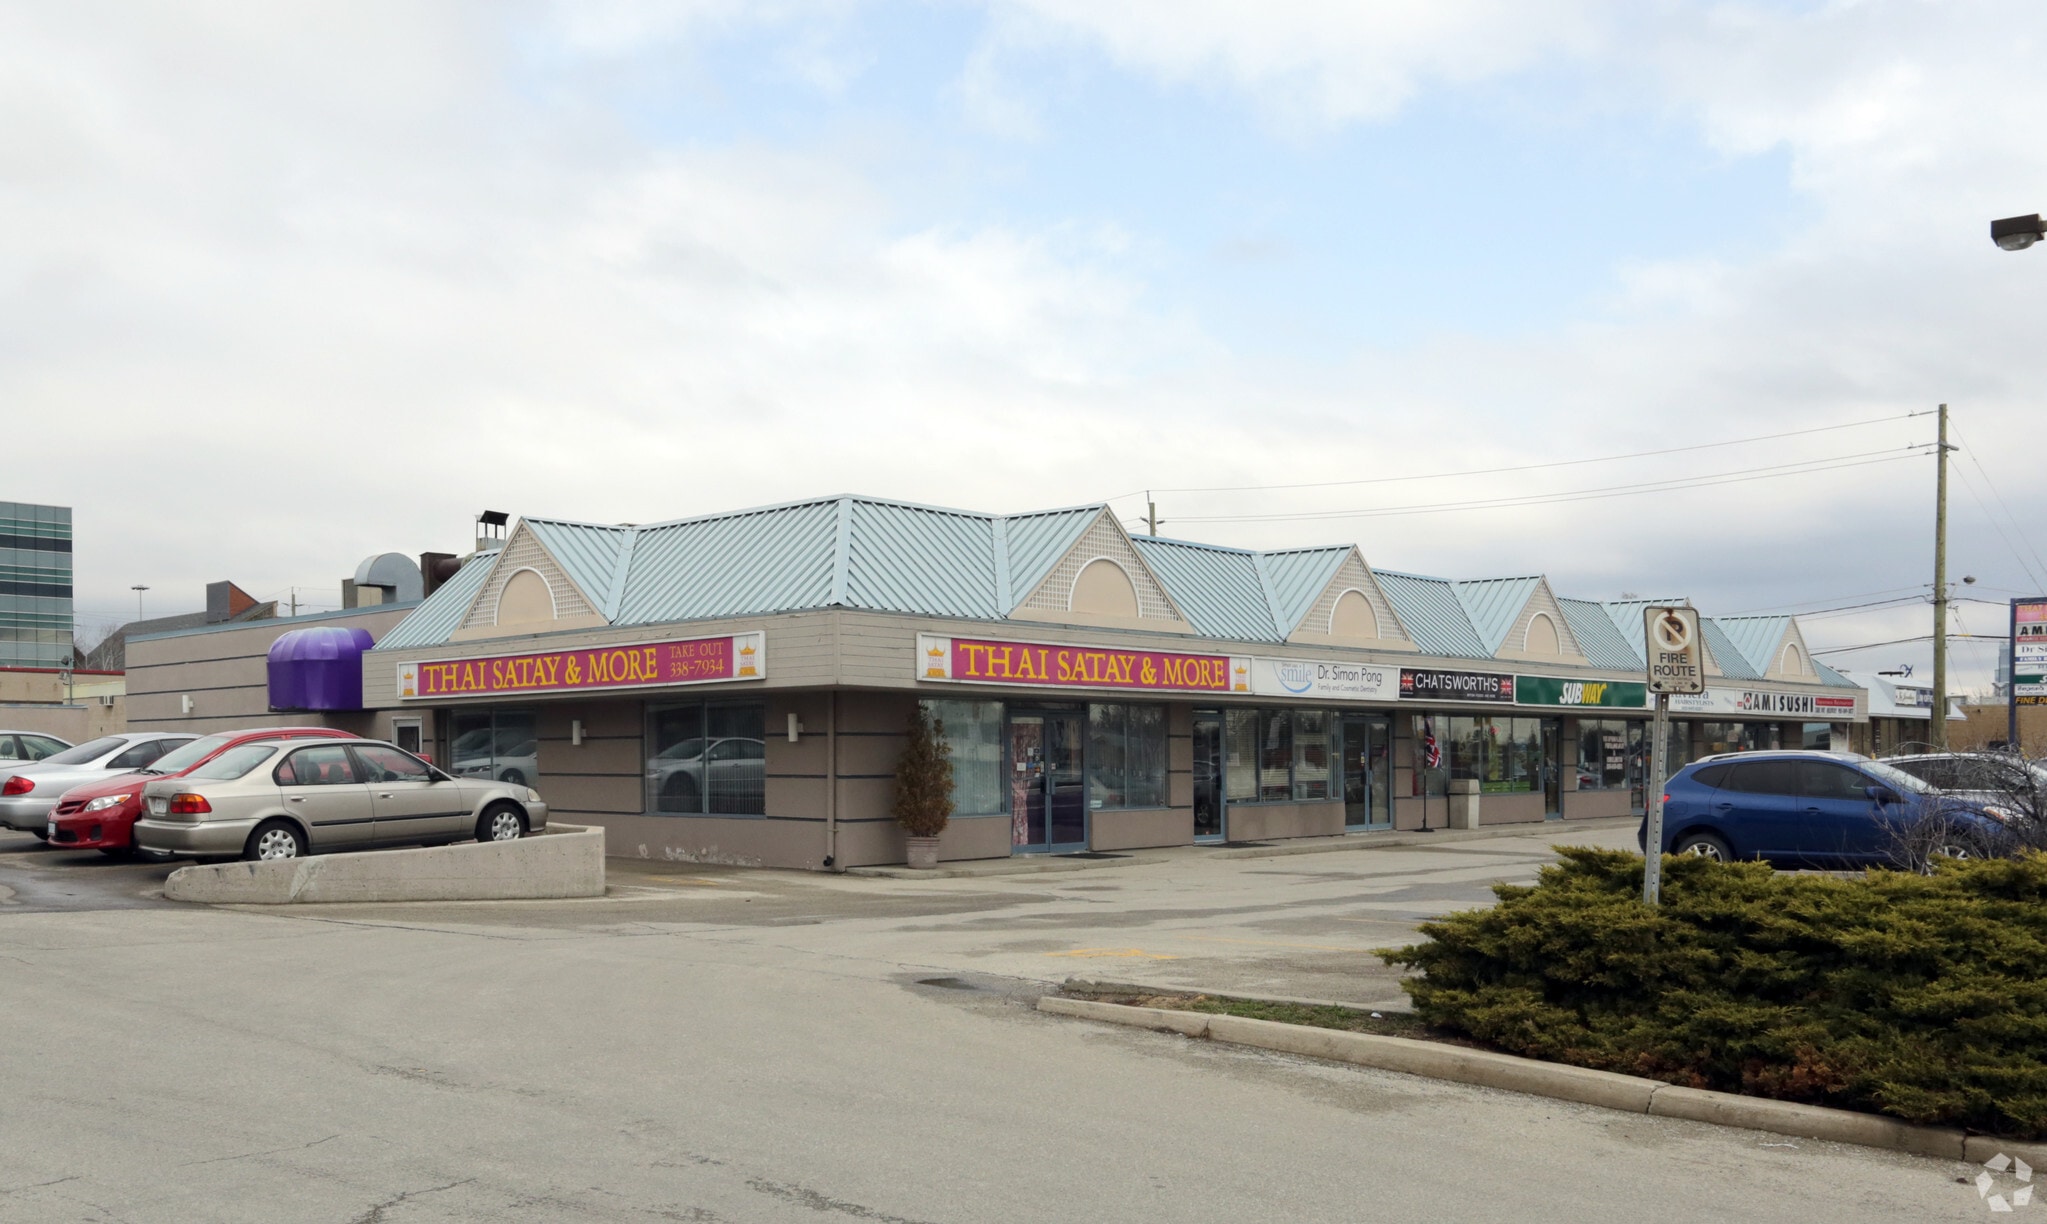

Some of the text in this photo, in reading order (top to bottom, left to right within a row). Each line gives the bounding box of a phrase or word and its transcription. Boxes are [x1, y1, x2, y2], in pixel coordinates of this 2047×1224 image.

[669, 642, 724, 659] TAKE OUT
[1660, 652, 1688, 664] FIRE
[423, 648, 658, 693] THAI SATAY & MORE
[670, 658, 724, 678] 338-7934
[960, 643, 1225, 688] THAI SATAY & MORE
[1281, 663, 1312, 683] smile
[1317, 664, 1330, 680] Dr.
[1332, 665, 1359, 681] Simon
[1361, 667, 1382, 687] Pong
[1653, 665, 1696, 677] ROUTE
[1415, 673, 1499, 692] CHATSWORTH'S
[1558, 682, 1608, 704] SUBWAY
[1753, 693, 1776, 711] AMI
[1779, 695, 1814, 713] SUSHI
